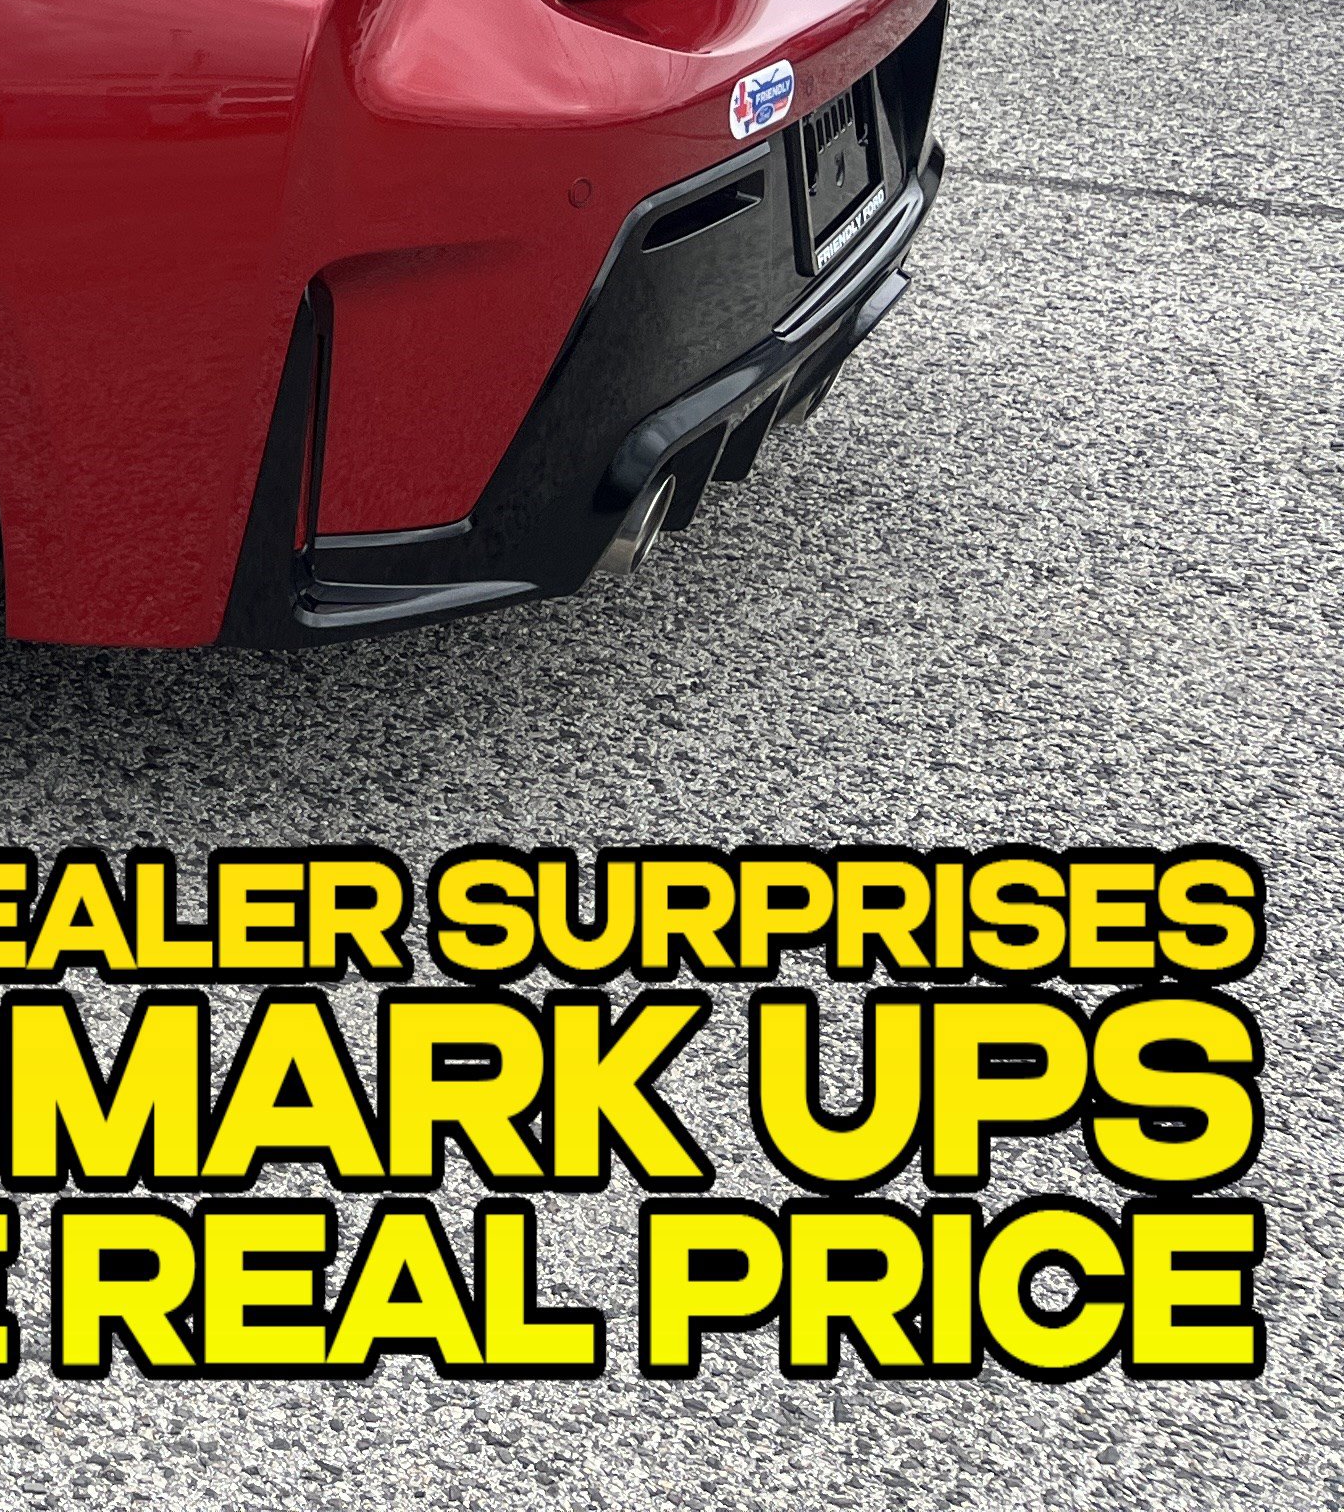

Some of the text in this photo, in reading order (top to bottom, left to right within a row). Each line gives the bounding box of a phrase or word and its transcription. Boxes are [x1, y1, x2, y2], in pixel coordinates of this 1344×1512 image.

[755, 79, 791, 106] FRIENDLY
[817, 188, 885, 268] FRIENDLY FORD
